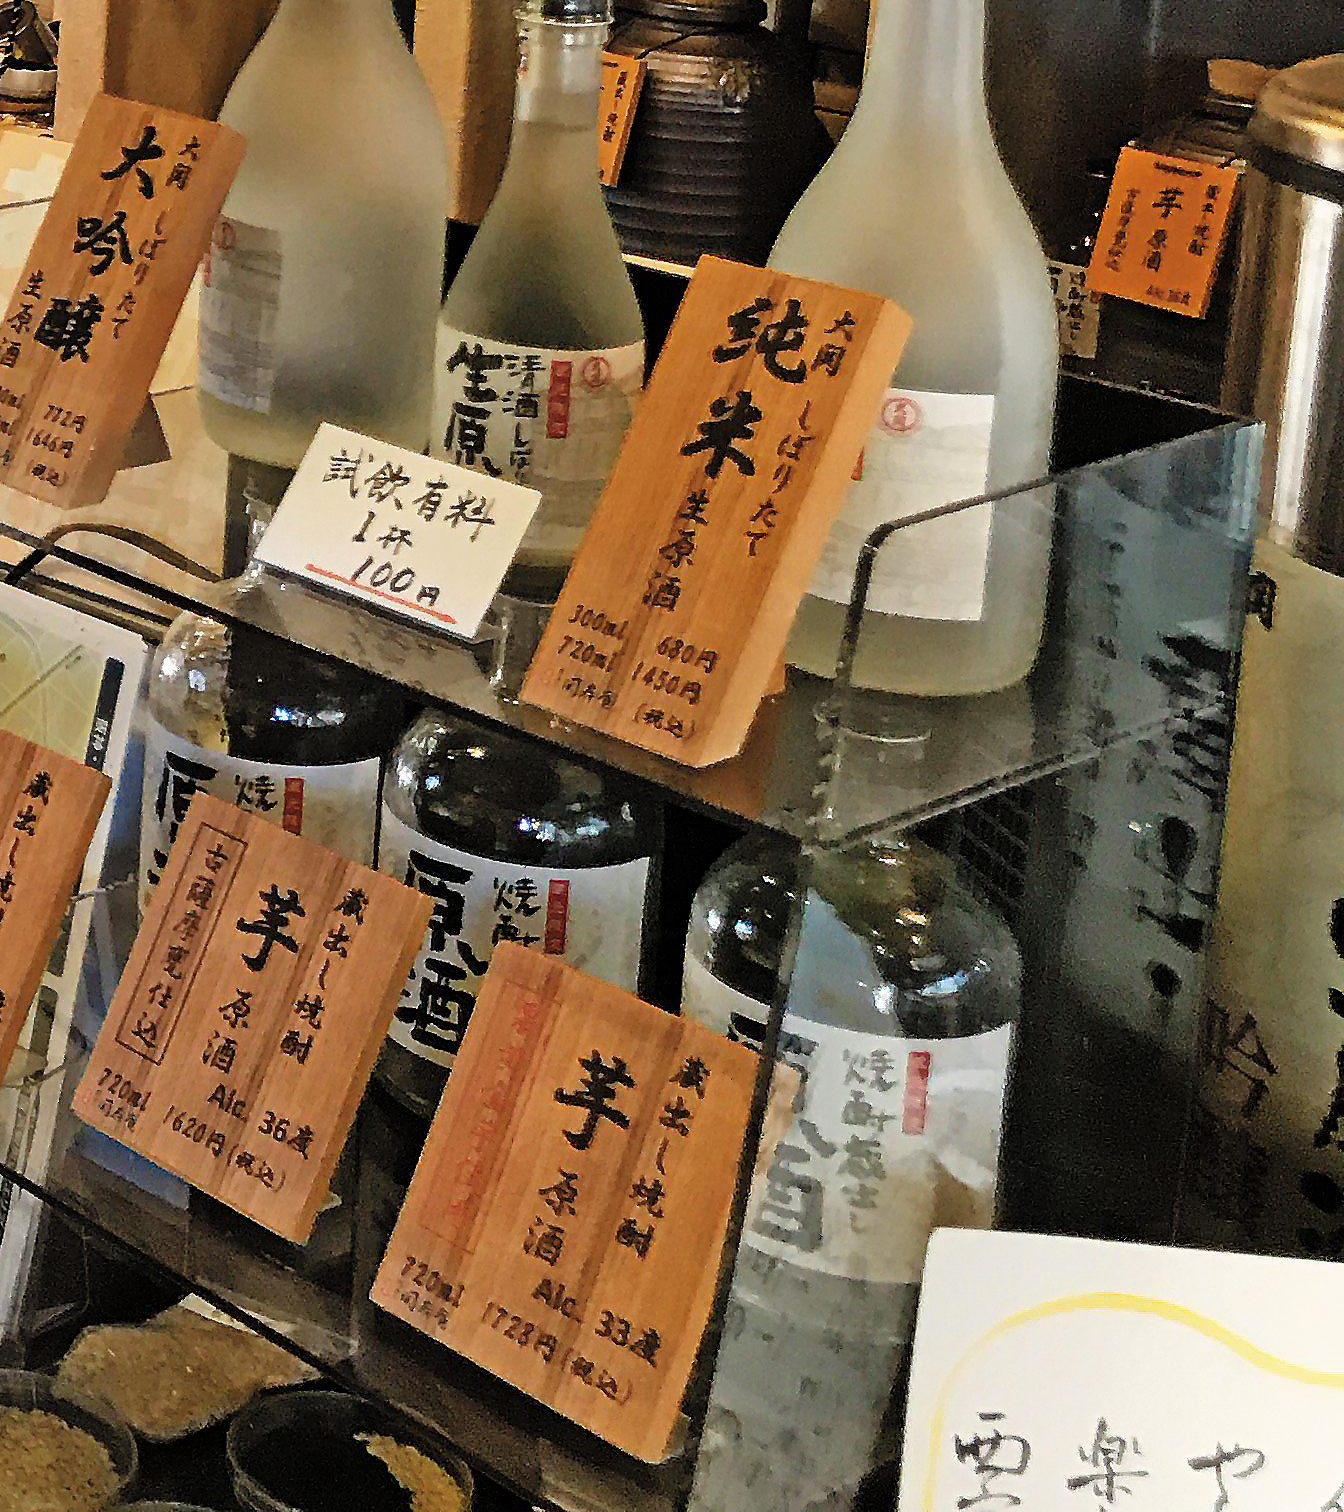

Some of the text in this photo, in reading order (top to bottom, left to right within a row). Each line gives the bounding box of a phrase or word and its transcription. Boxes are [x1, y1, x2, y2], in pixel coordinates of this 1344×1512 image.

[35, 126, 164, 363] 大吟醸
[680, 296, 810, 480] 純米
[322, 448, 495, 543] 試飲有料
[640, 488, 711, 613] 生原酒
[351, 555, 441, 607] 100円
[567, 604, 630, 642] 300ml
[556, 634, 622, 675] 720ml
[631, 659, 703, 706] 1450円
[656, 635, 721, 675] 680円
[201, 884, 307, 1074] 芋 原酒
[280, 888, 370, 1065] 蔵出し焼酎
[97, 1068, 152, 1113] 720ml
[257, 1110, 315, 1161] 36度
[522, 1049, 636, 1267] 芋 原酒
[614, 1055, 712, 1259] 蔵出し焼酎
[400, 1256, 466, 1308] 720ml
[595, 1309, 664, 1368] 33度
